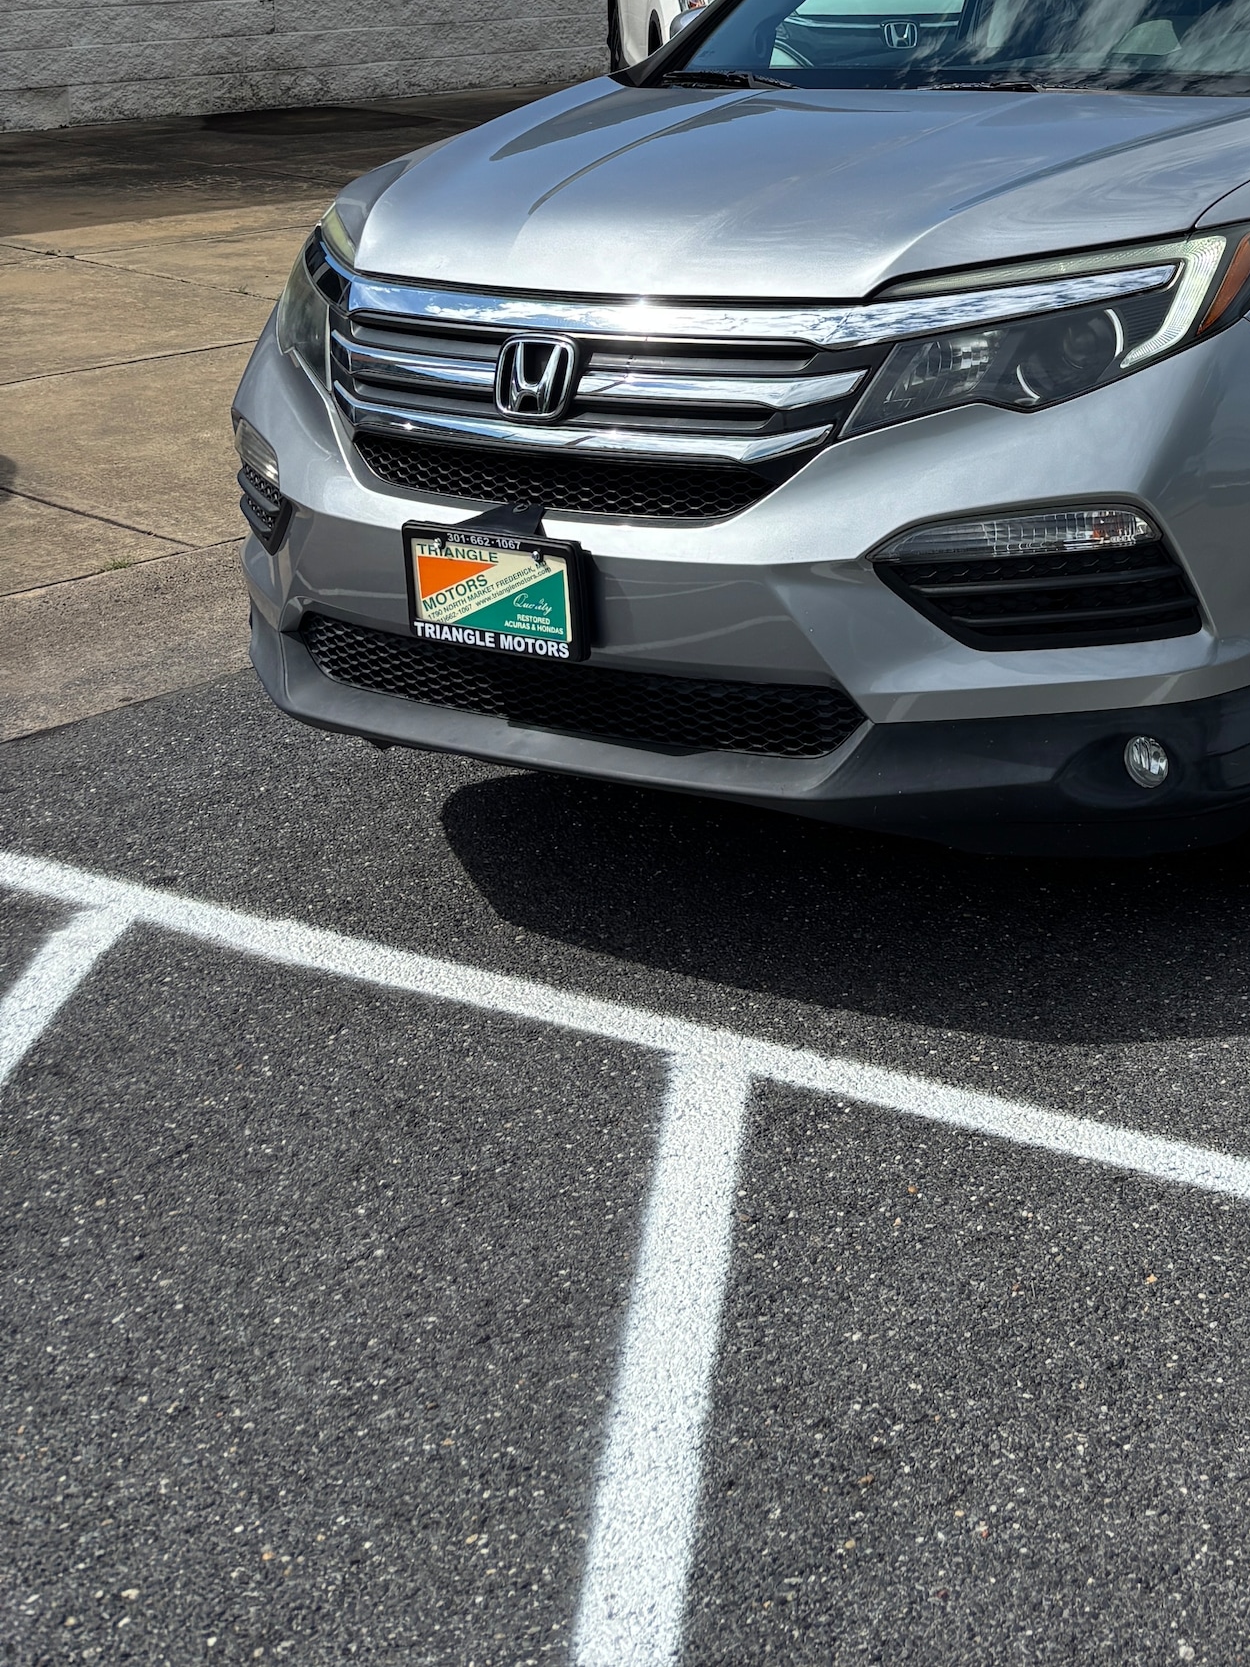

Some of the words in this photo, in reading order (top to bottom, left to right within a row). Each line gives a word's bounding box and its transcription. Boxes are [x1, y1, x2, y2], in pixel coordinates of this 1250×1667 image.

[416, 543, 500, 564] TRIANGLE
[422, 574, 489, 612] MOTORS
[443, 598, 467, 612] NORTH
[467, 584, 495, 602] MARKET
[504, 620, 530, 630] ACURAS
[536, 624, 564, 635] HONDAS
[516, 613, 551, 625] RESTORED
[413, 621, 496, 648] TRIANGLE
[499, 633, 570, 659] MOTORS
